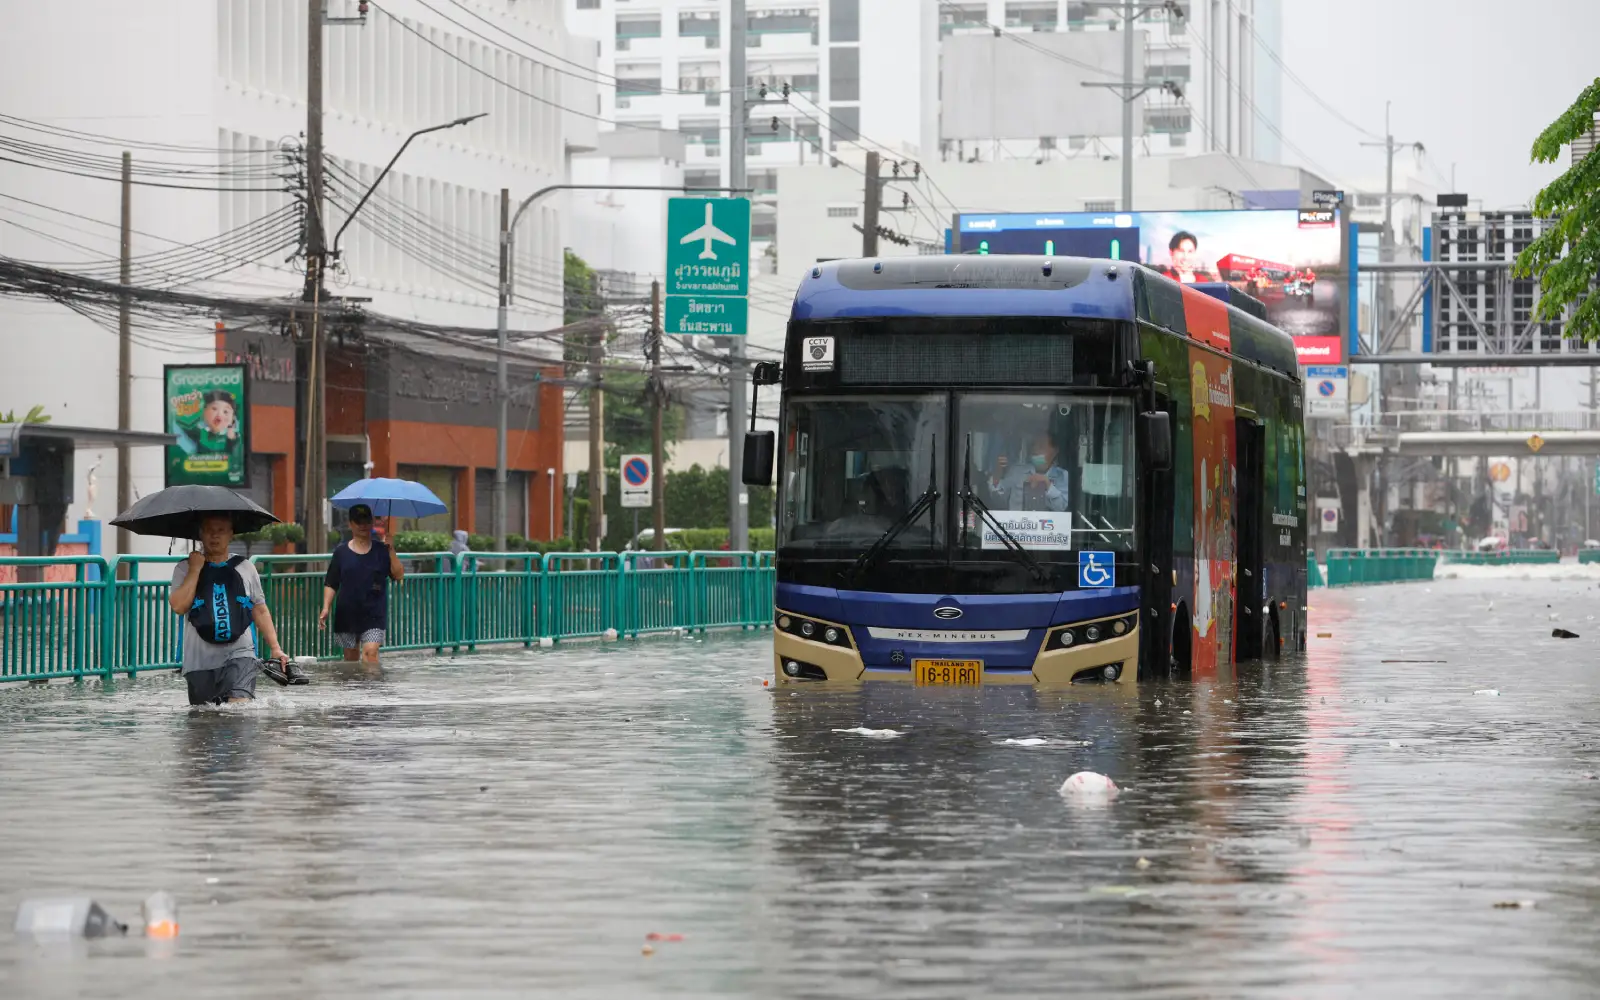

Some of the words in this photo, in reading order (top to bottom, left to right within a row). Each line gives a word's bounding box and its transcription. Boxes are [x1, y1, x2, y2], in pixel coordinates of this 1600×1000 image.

[674, 262, 741, 282] สุวรรณภูมิ
[675, 281, 740, 290] Suvarnabhumi
[688, 299, 725, 313] ชิดขวา
[679, 315, 733, 332] ขึ้นสะพาน
[172, 372, 240, 386] GrabFood
[215, 592, 228, 640] ADIDAS
[898, 632, 996, 640] NEX-MINEBUS
[922, 667, 976, 684] 16-8180
